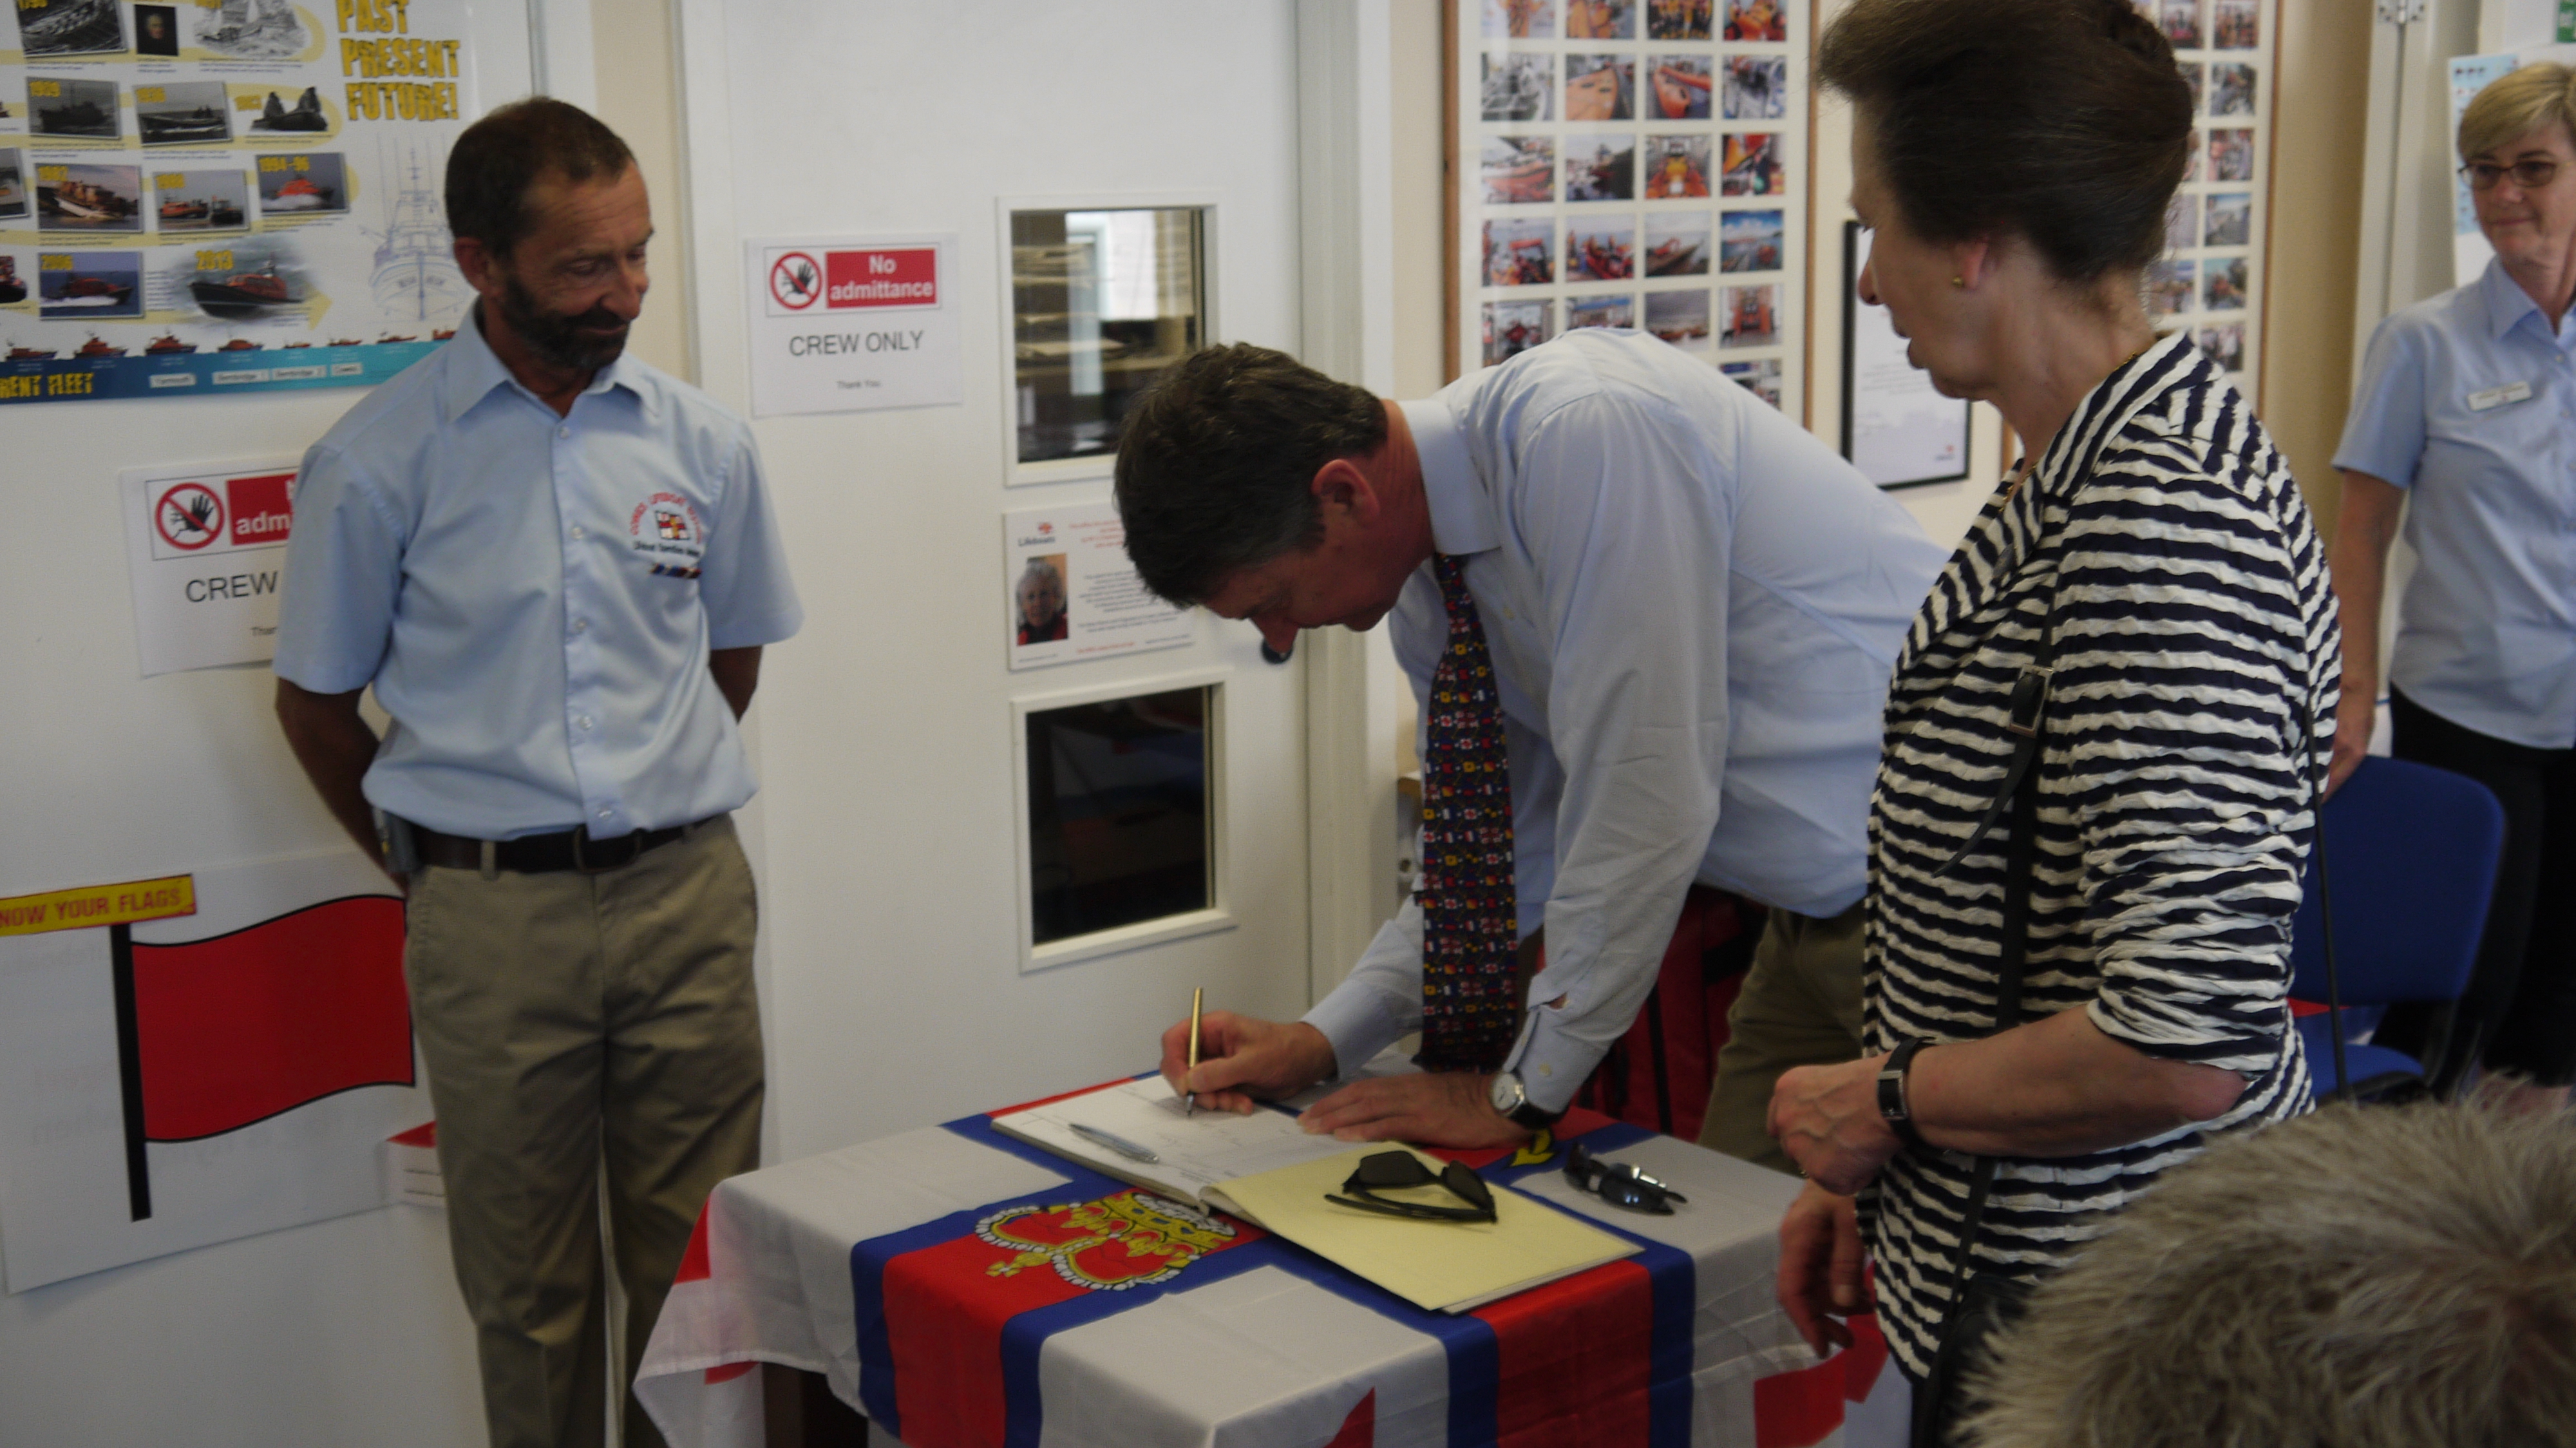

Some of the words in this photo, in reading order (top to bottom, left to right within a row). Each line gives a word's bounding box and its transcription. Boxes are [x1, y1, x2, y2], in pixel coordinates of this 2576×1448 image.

[336, 0, 409, 33] PAST
[340, 38, 460, 78] PRESENT
[345, 82, 459, 121] FUTURE!
[195, 249, 234, 271] 2013
[869, 255, 897, 275] No
[829, 280, 934, 301] admittance
[789, 333, 860, 356] CREW
[866, 330, 923, 353] ONLY
[47, 372, 95, 397] FLEET
[235, 512, 291, 536] adm
[185, 571, 278, 603] CREW
[55, 897, 109, 921] YOUR
[118, 888, 181, 913] FLAGS
